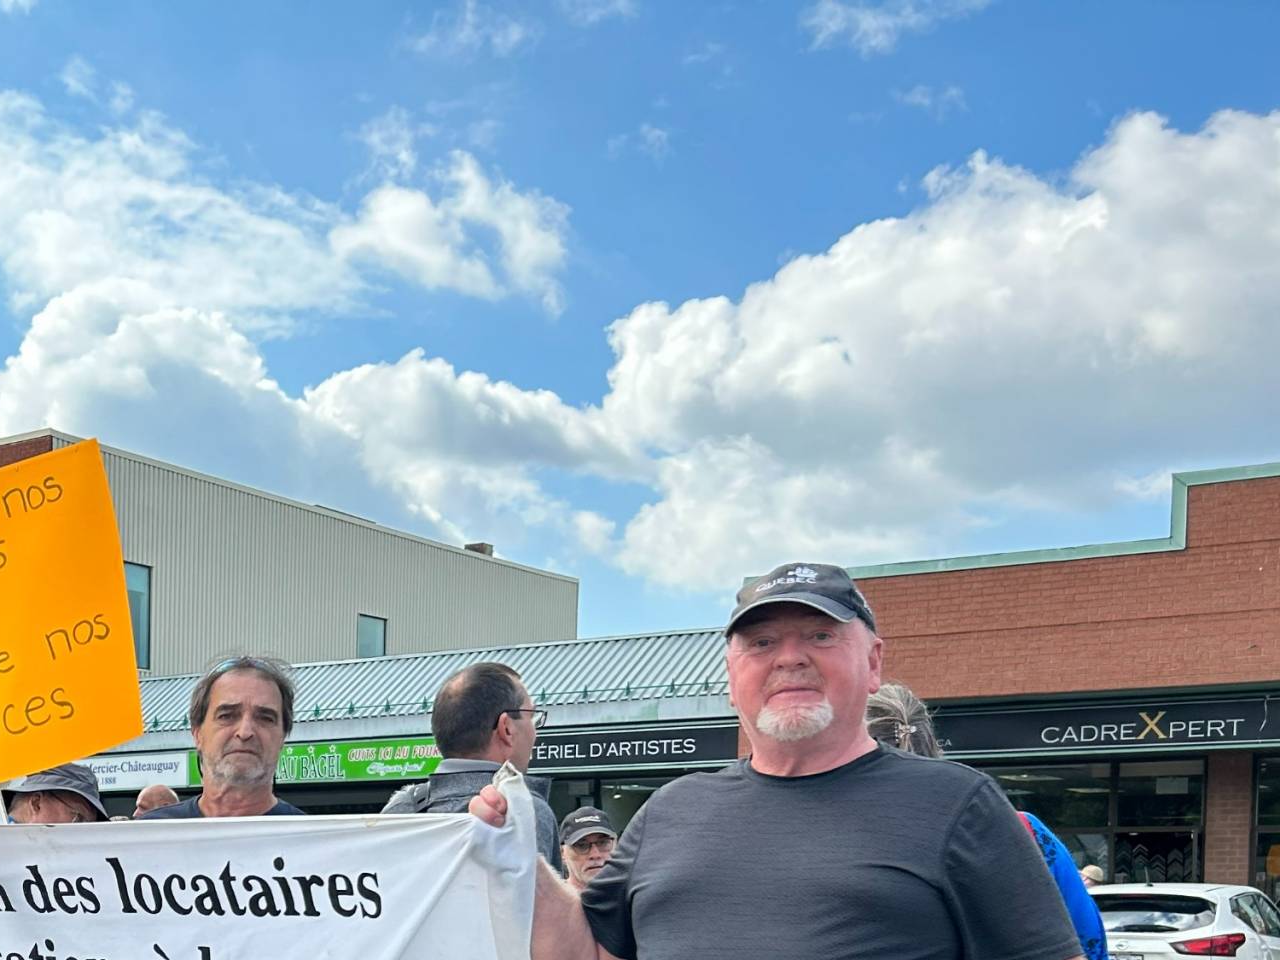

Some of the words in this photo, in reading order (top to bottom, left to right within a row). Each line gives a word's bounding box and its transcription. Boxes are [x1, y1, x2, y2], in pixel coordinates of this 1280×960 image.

[1, 474, 63, 518] nos
[44, 612, 110, 660] nos
[529, 742, 586, 760] TÉRIEL
[589, 738, 696, 758] D'ARTISTES
[1040, 710, 1246, 744] CADREXPERT
[22, 864, 101, 914] des
[105, 857, 382, 919] locataires
